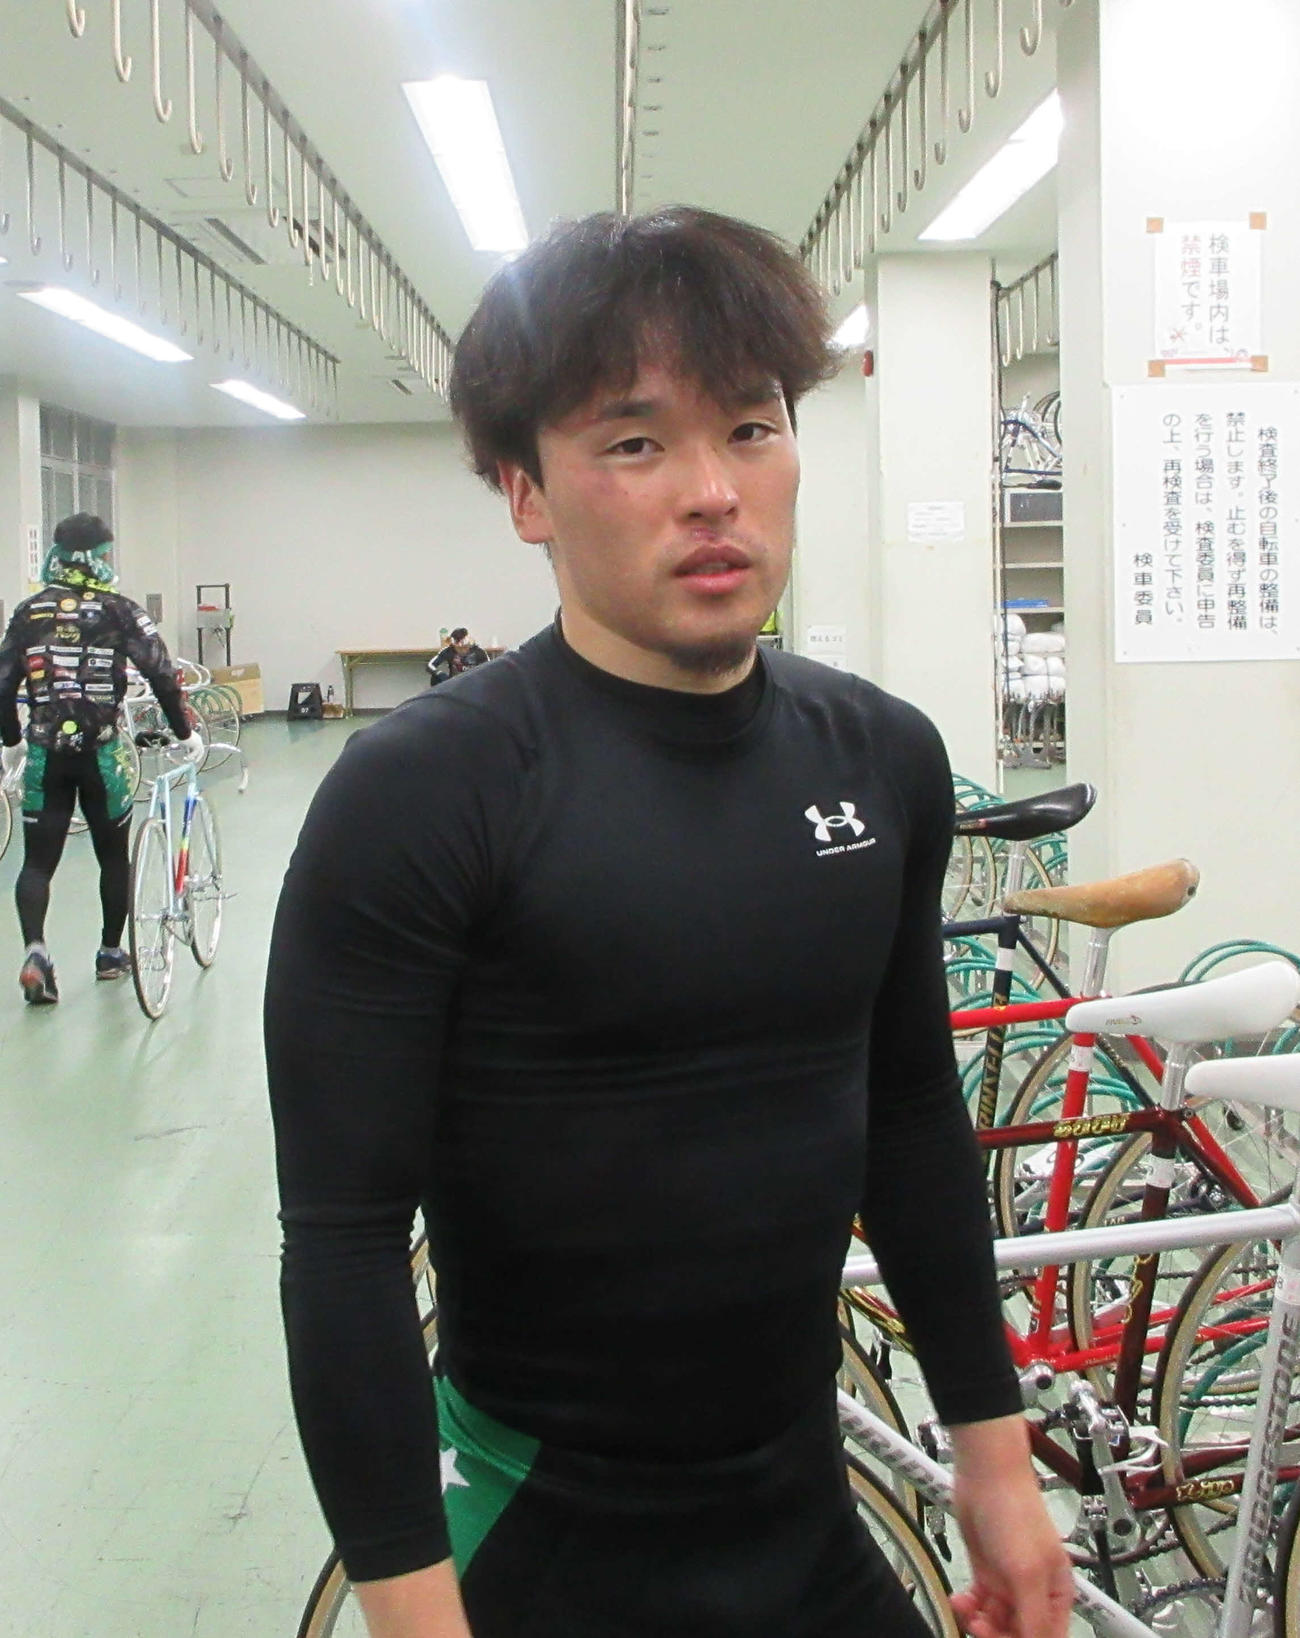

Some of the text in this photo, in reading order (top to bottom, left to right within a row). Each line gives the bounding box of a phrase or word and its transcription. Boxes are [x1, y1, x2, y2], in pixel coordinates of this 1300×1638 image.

[1181, 234, 1203, 330] 禁煙です。
[1208, 234, 1233, 356] 検車場内は、
[1133, 552, 1154, 626] 検車委員
[816, 838, 876, 856] UNDER ARMOUR
